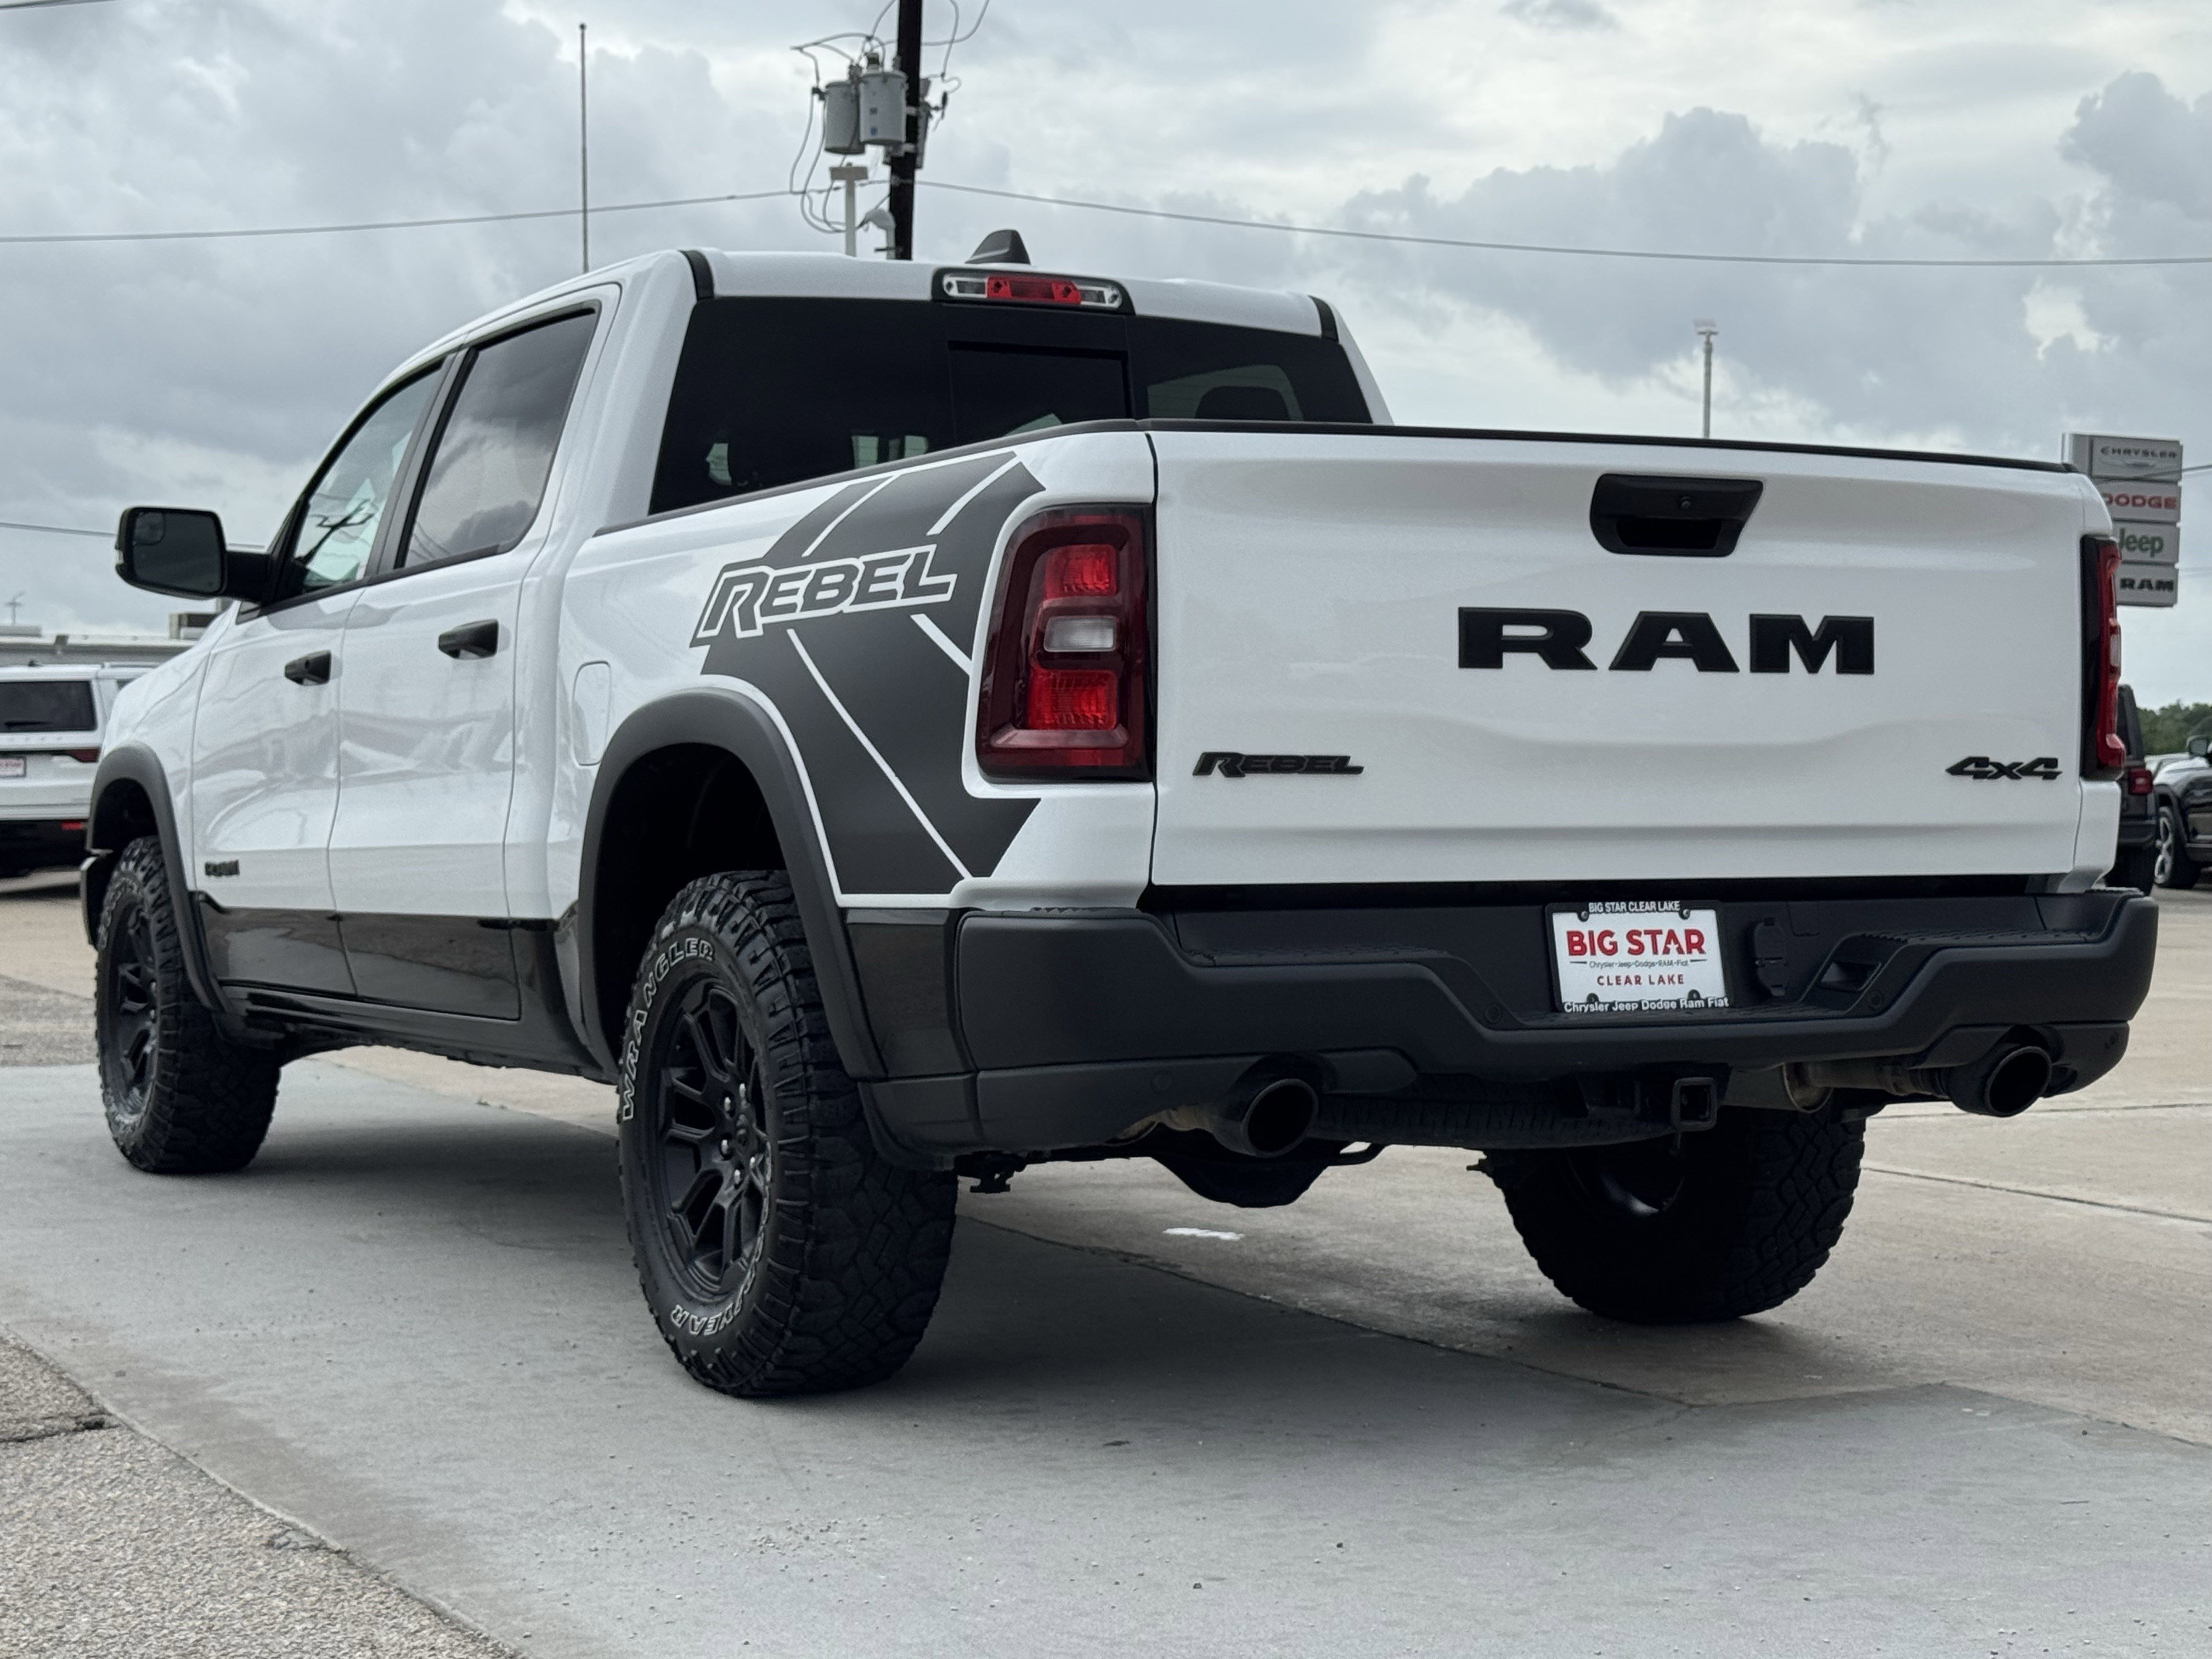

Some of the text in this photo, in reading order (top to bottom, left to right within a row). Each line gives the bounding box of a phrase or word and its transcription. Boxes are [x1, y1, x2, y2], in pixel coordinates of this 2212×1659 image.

[2101, 445, 2177, 458] CHRYSLER
[2118, 528, 2164, 557] Jeep
[696, 543, 958, 639] REBEL
[2120, 578, 2174, 591] RAM
[1458, 607, 1875, 675] RAM
[1193, 752, 1365, 777] REBEL
[1589, 900, 1680, 912] BIG STAR CLEAR LAKE
[1566, 929, 1706, 956] BIG STAR
[1597, 974, 1684, 986] CLEAR LAKE
[1564, 996, 1729, 1013] Chrysler Jeep Dodge Ram Fiat
[623, 937, 715, 1121] WRANGLER
